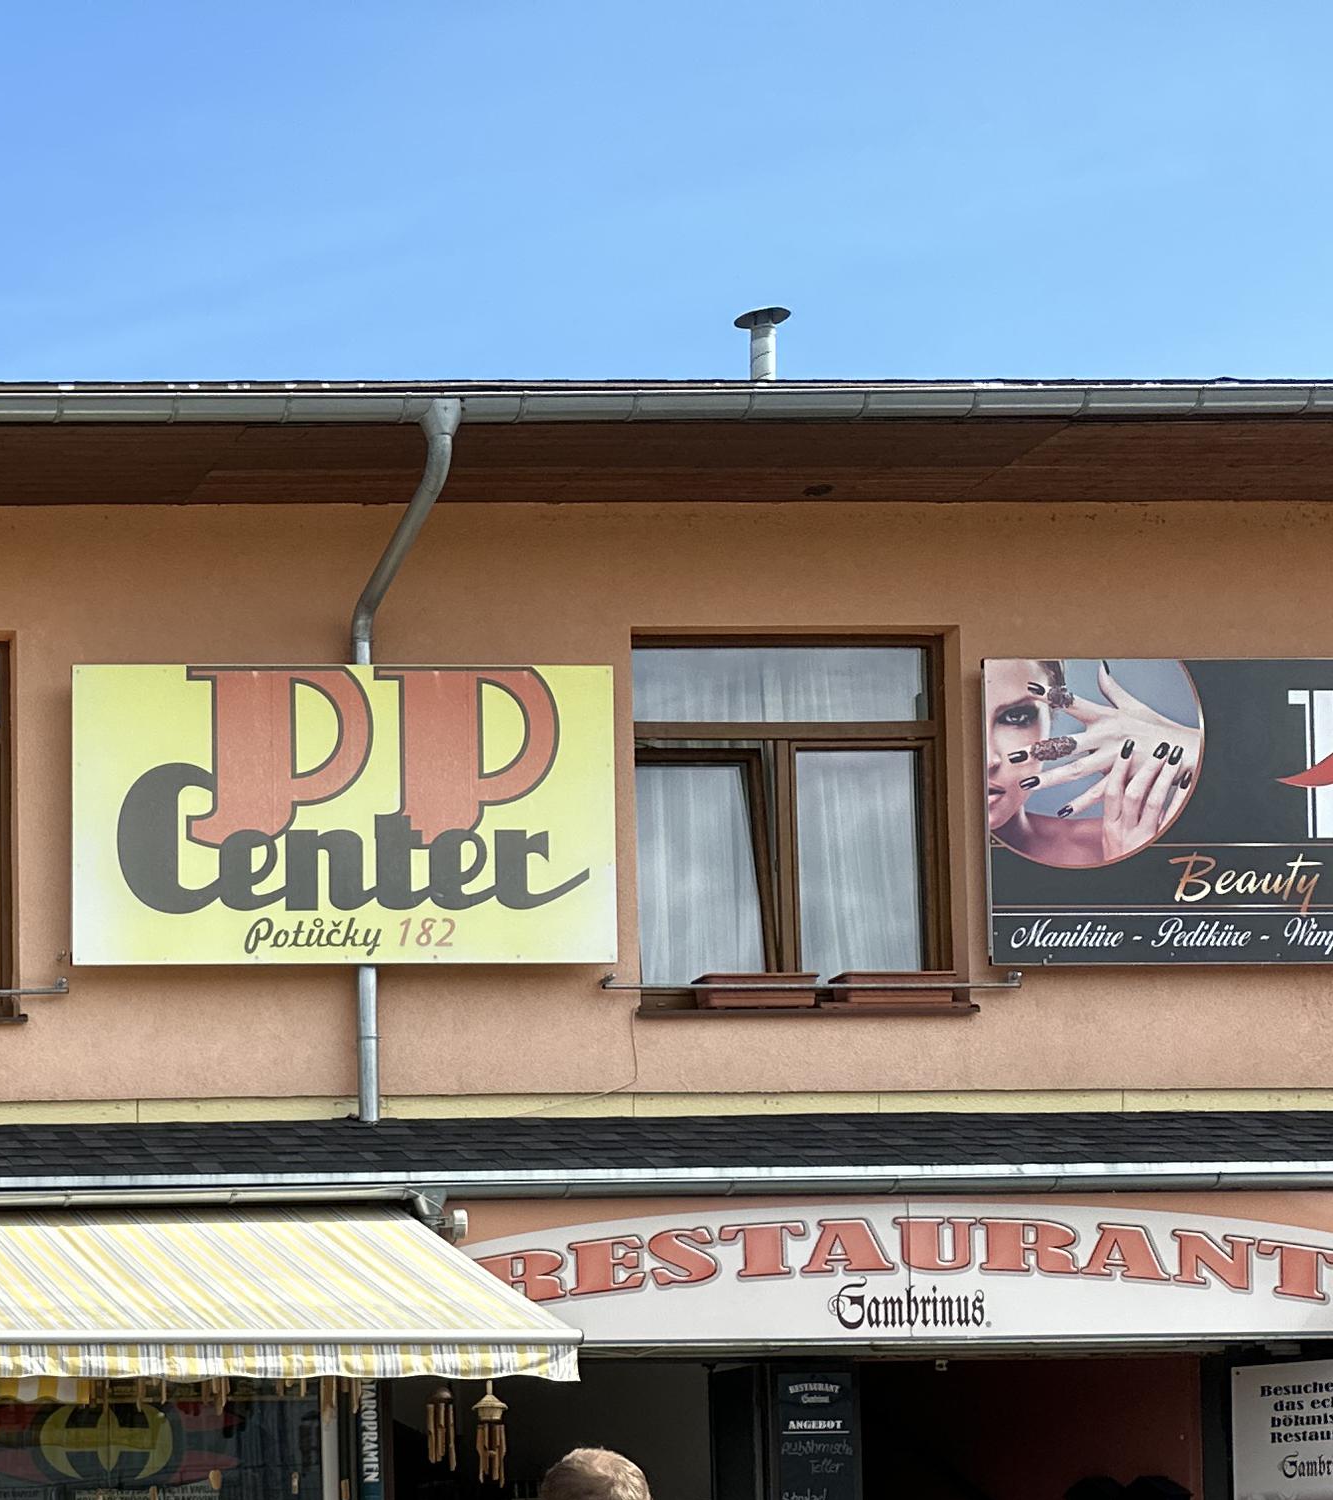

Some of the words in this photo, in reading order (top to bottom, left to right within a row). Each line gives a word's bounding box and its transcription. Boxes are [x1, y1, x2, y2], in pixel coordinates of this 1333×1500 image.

[186, 665, 560, 849] PP
[117, 762, 590, 915] Center
[1167, 851, 1325, 918] Beauty
[244, 917, 382, 956] Potůčky
[397, 917, 456, 948] 182
[1010, 918, 1125, 949] Maniküre
[1151, 916, 1252, 949] Pediküre
[472, 1216, 1333, 1302] RESTAURANT
[827, 1275, 985, 1330] Gambrinus
[788, 1419, 844, 1431] ANGEBOT
[1273, 1400, 1304, 1412] das
[1310, 1397, 1333, 1410] ec
